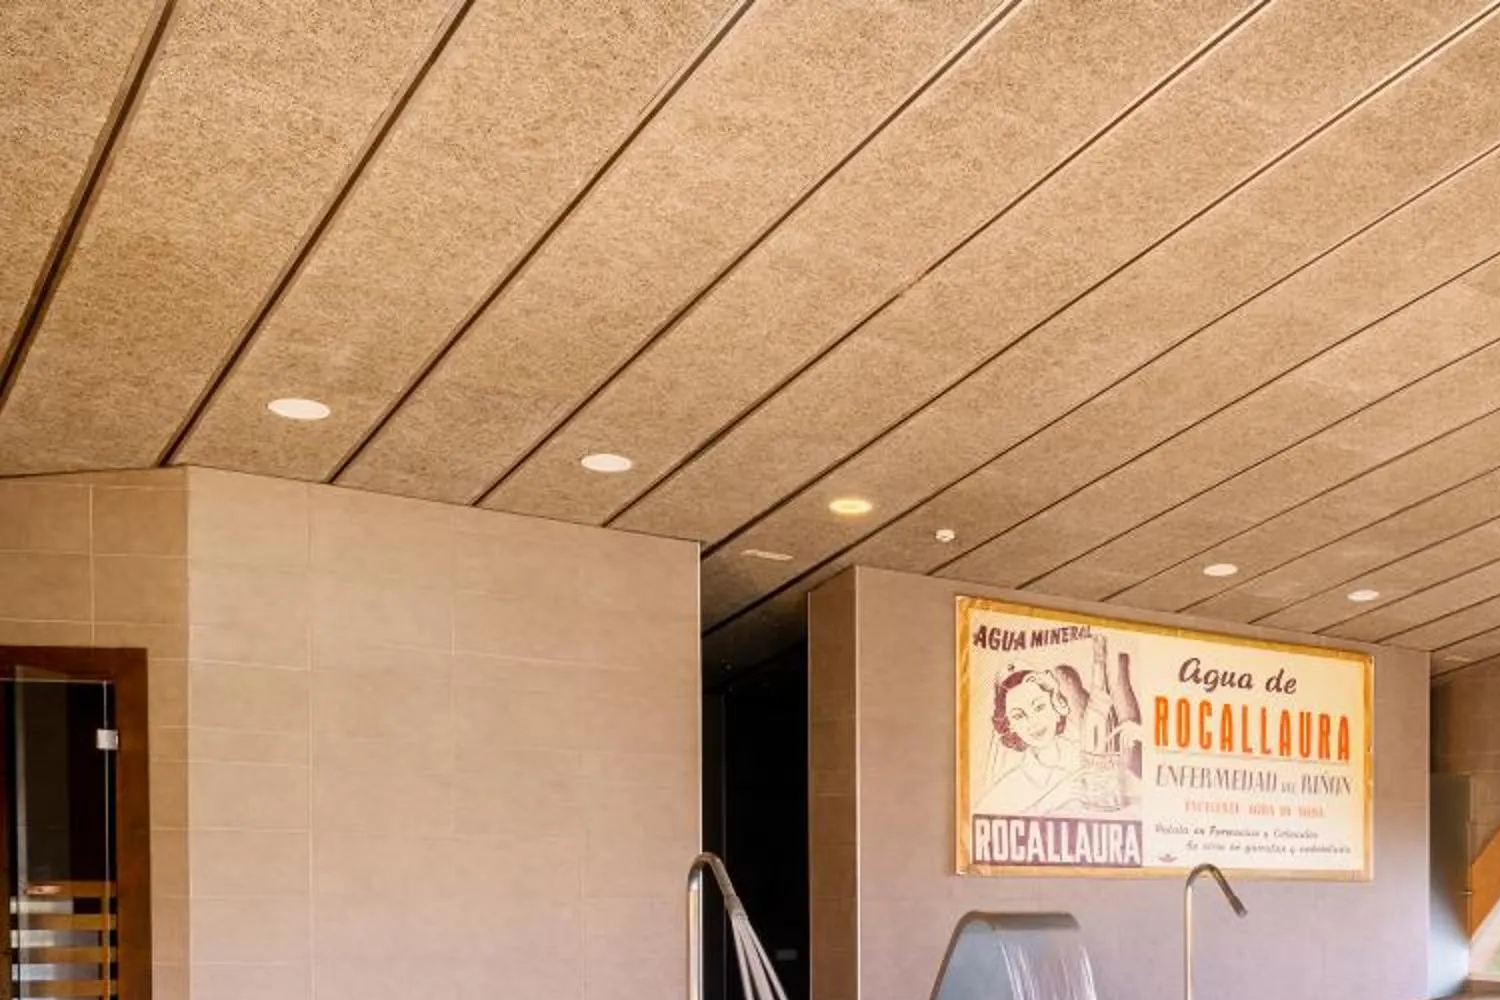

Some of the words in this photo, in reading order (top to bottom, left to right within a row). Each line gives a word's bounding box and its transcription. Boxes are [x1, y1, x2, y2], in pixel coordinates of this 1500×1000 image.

[973, 625, 1026, 651] AGUA
[1030, 625, 1092, 648] MINERAL
[1178, 657, 1254, 693] Agua
[1265, 667, 1297, 695] de
[1154, 696, 1350, 761] ROCALLAURA
[1155, 764, 1277, 793] ENFERMEDAD
[975, 818, 1141, 864] ROCALLAURA
